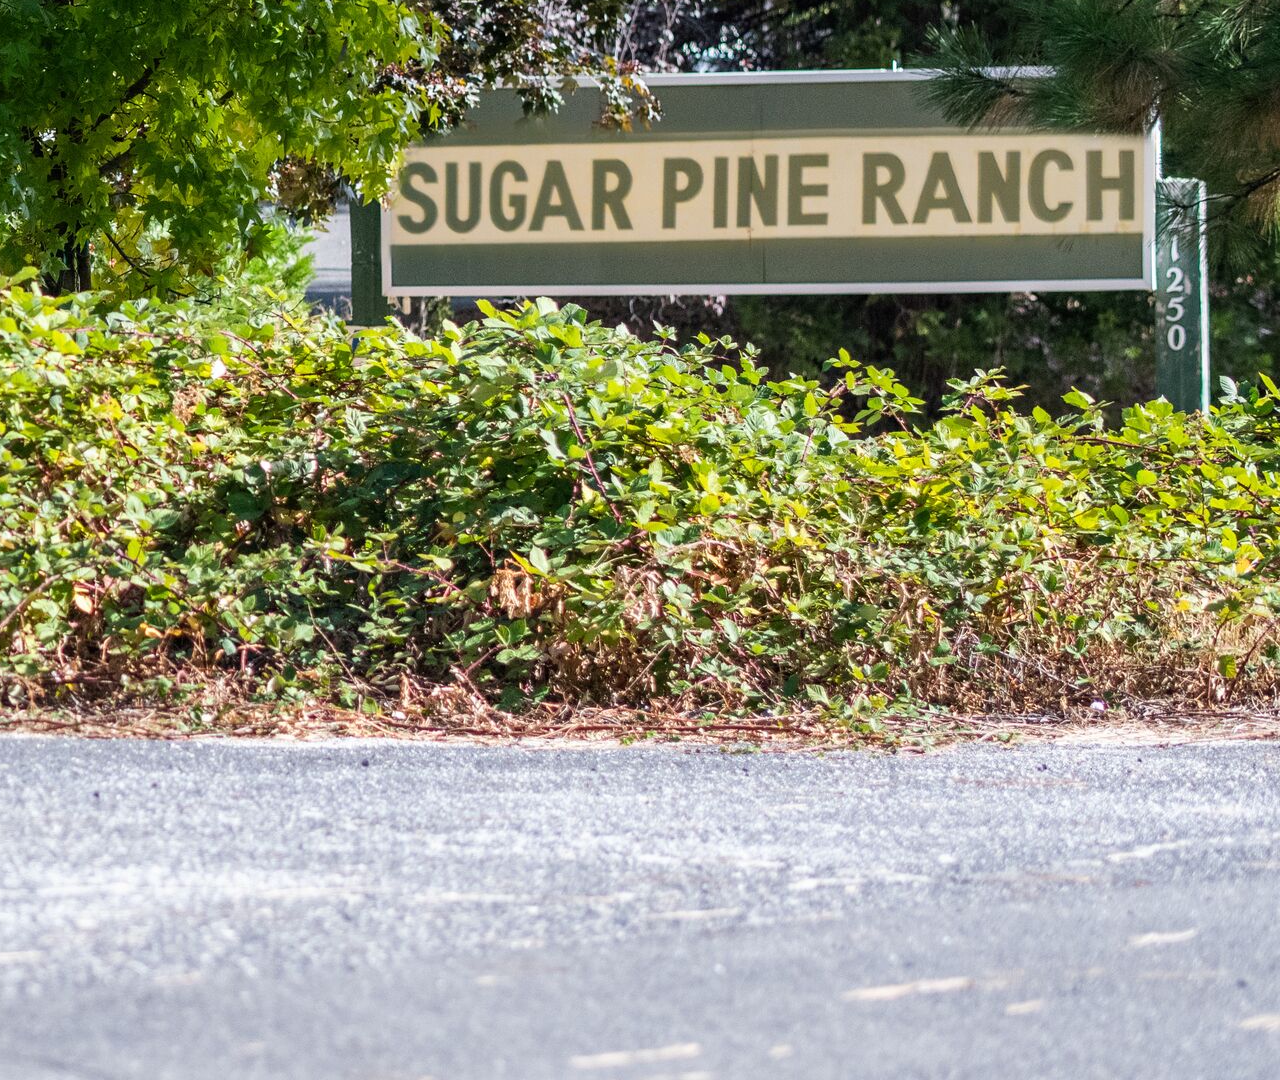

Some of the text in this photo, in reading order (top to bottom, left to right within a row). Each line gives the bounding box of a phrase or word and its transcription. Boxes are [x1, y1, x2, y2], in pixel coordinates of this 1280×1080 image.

[397, 149, 1135, 234] SUGAR PINE RANCH
[1166, 234, 1186, 351] 1250
